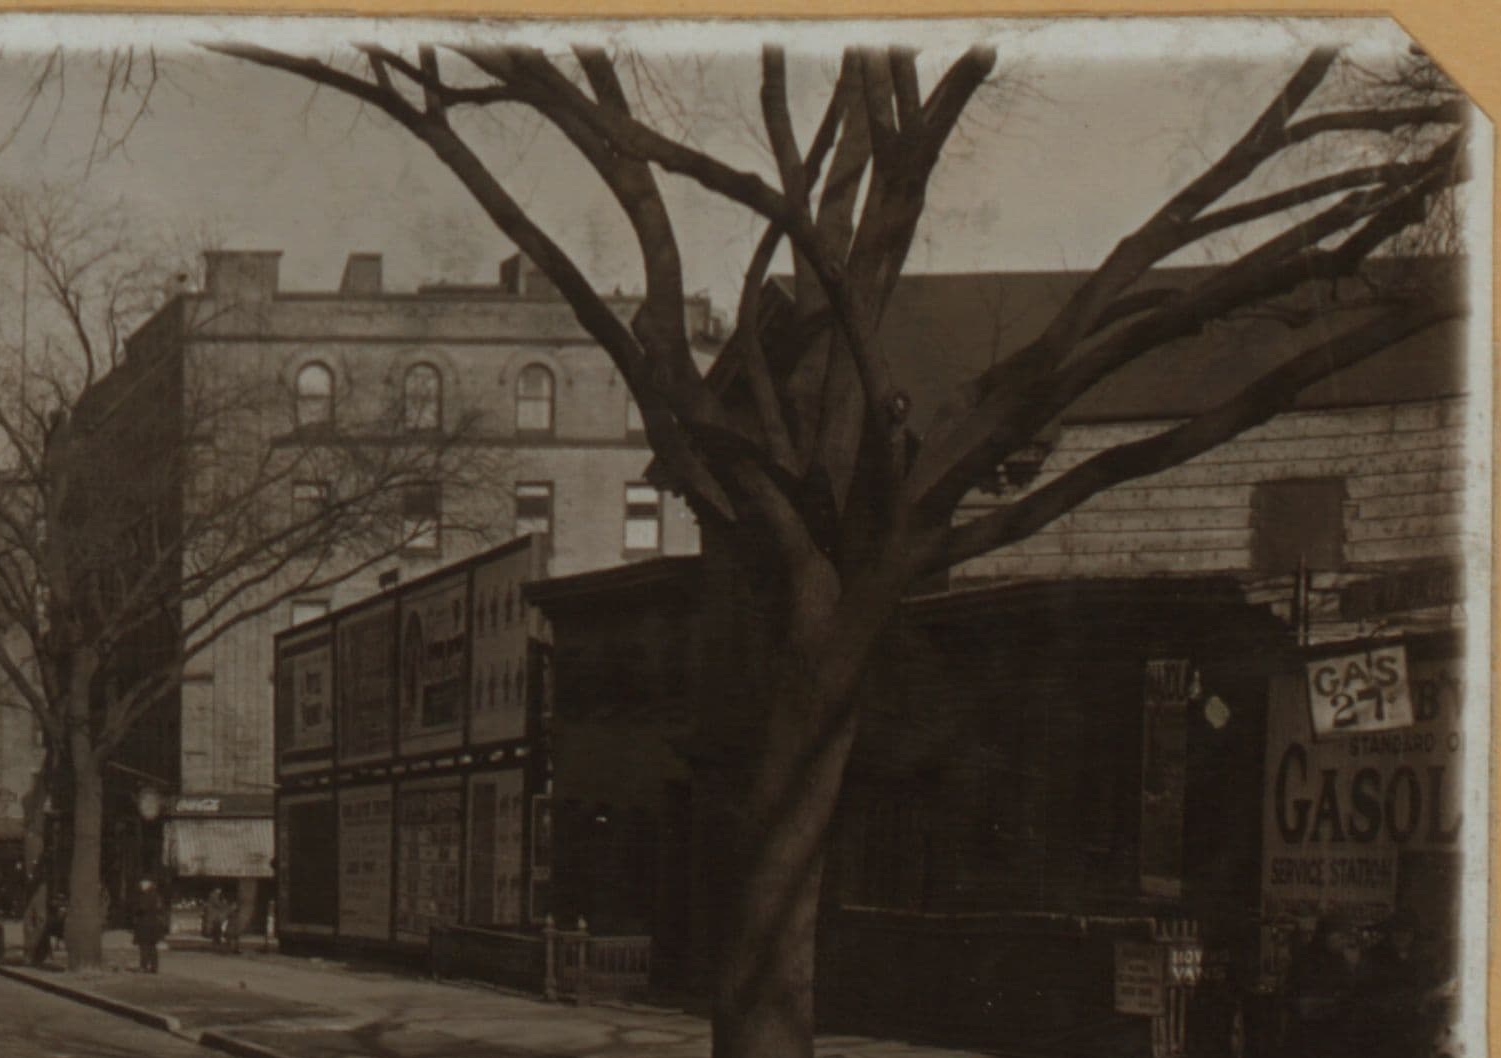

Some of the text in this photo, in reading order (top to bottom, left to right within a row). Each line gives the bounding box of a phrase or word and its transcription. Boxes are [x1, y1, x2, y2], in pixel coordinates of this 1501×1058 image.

[1314, 655, 1399, 697] GAS
[1349, 732, 1436, 757] STANDARD
[1270, 857, 1393, 888] SERVICE STATION
